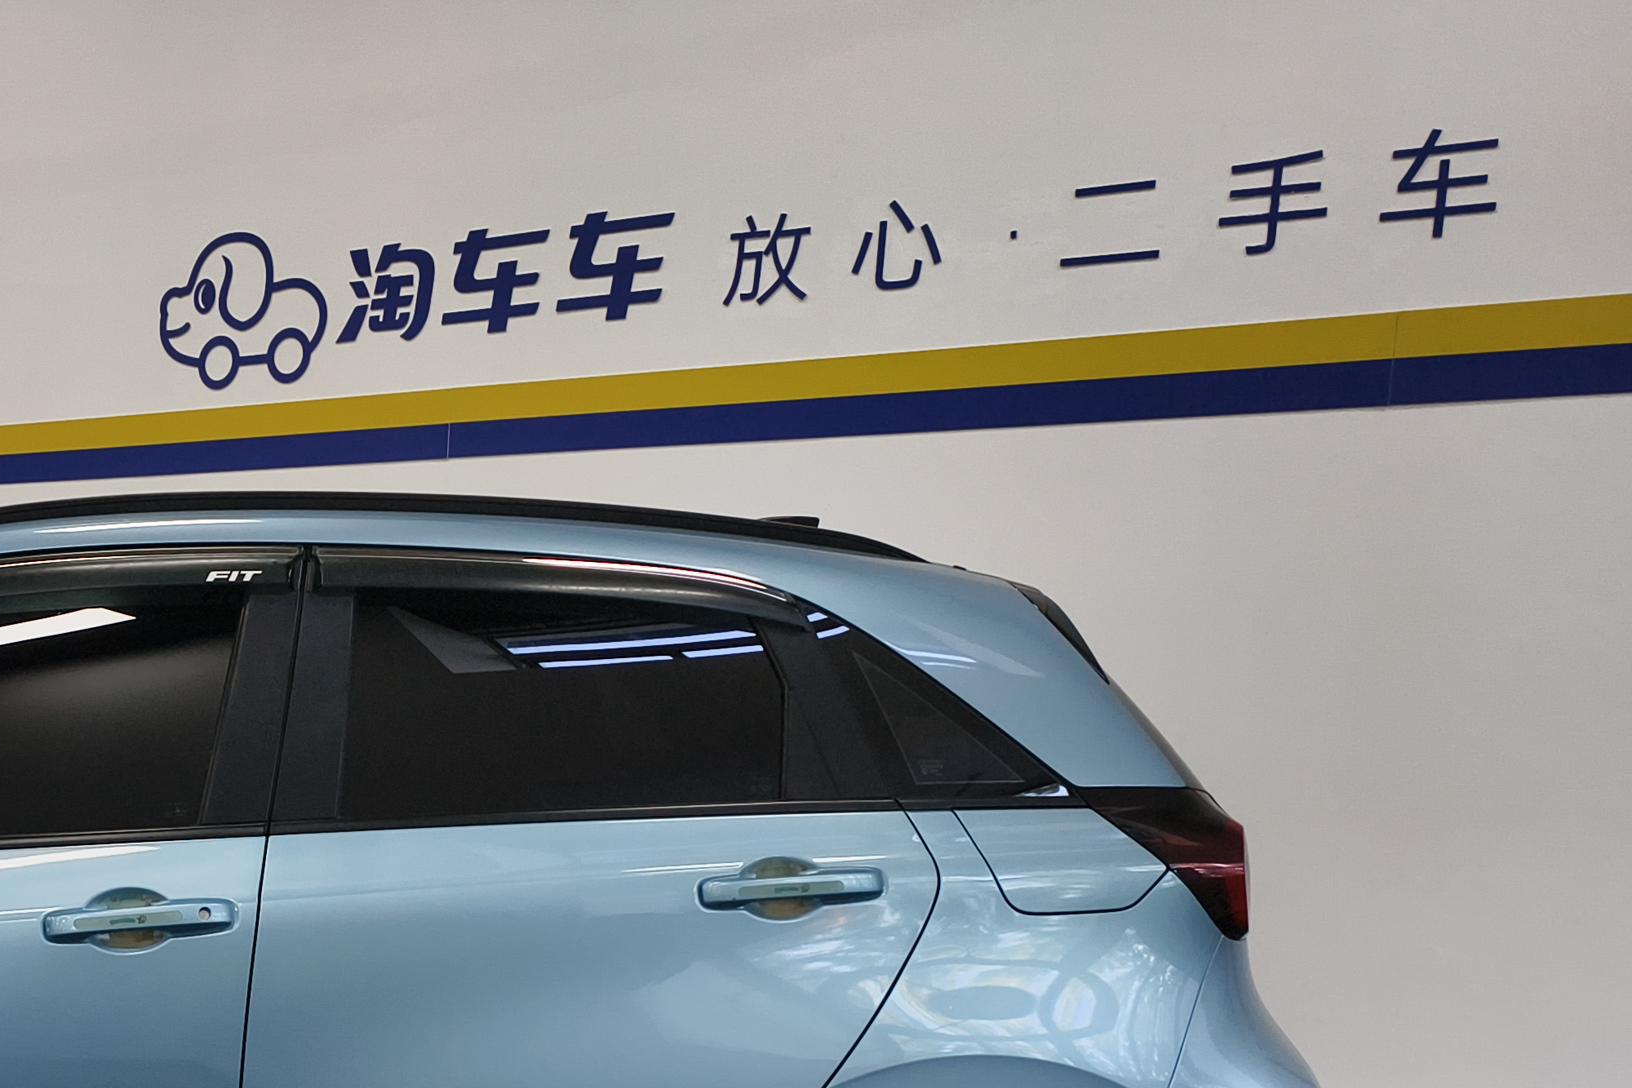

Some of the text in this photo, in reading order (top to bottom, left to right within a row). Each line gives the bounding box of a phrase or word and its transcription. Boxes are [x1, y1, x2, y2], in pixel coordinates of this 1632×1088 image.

[335, 211, 675, 344] 淘车车
[206, 570, 263, 582] FIT
